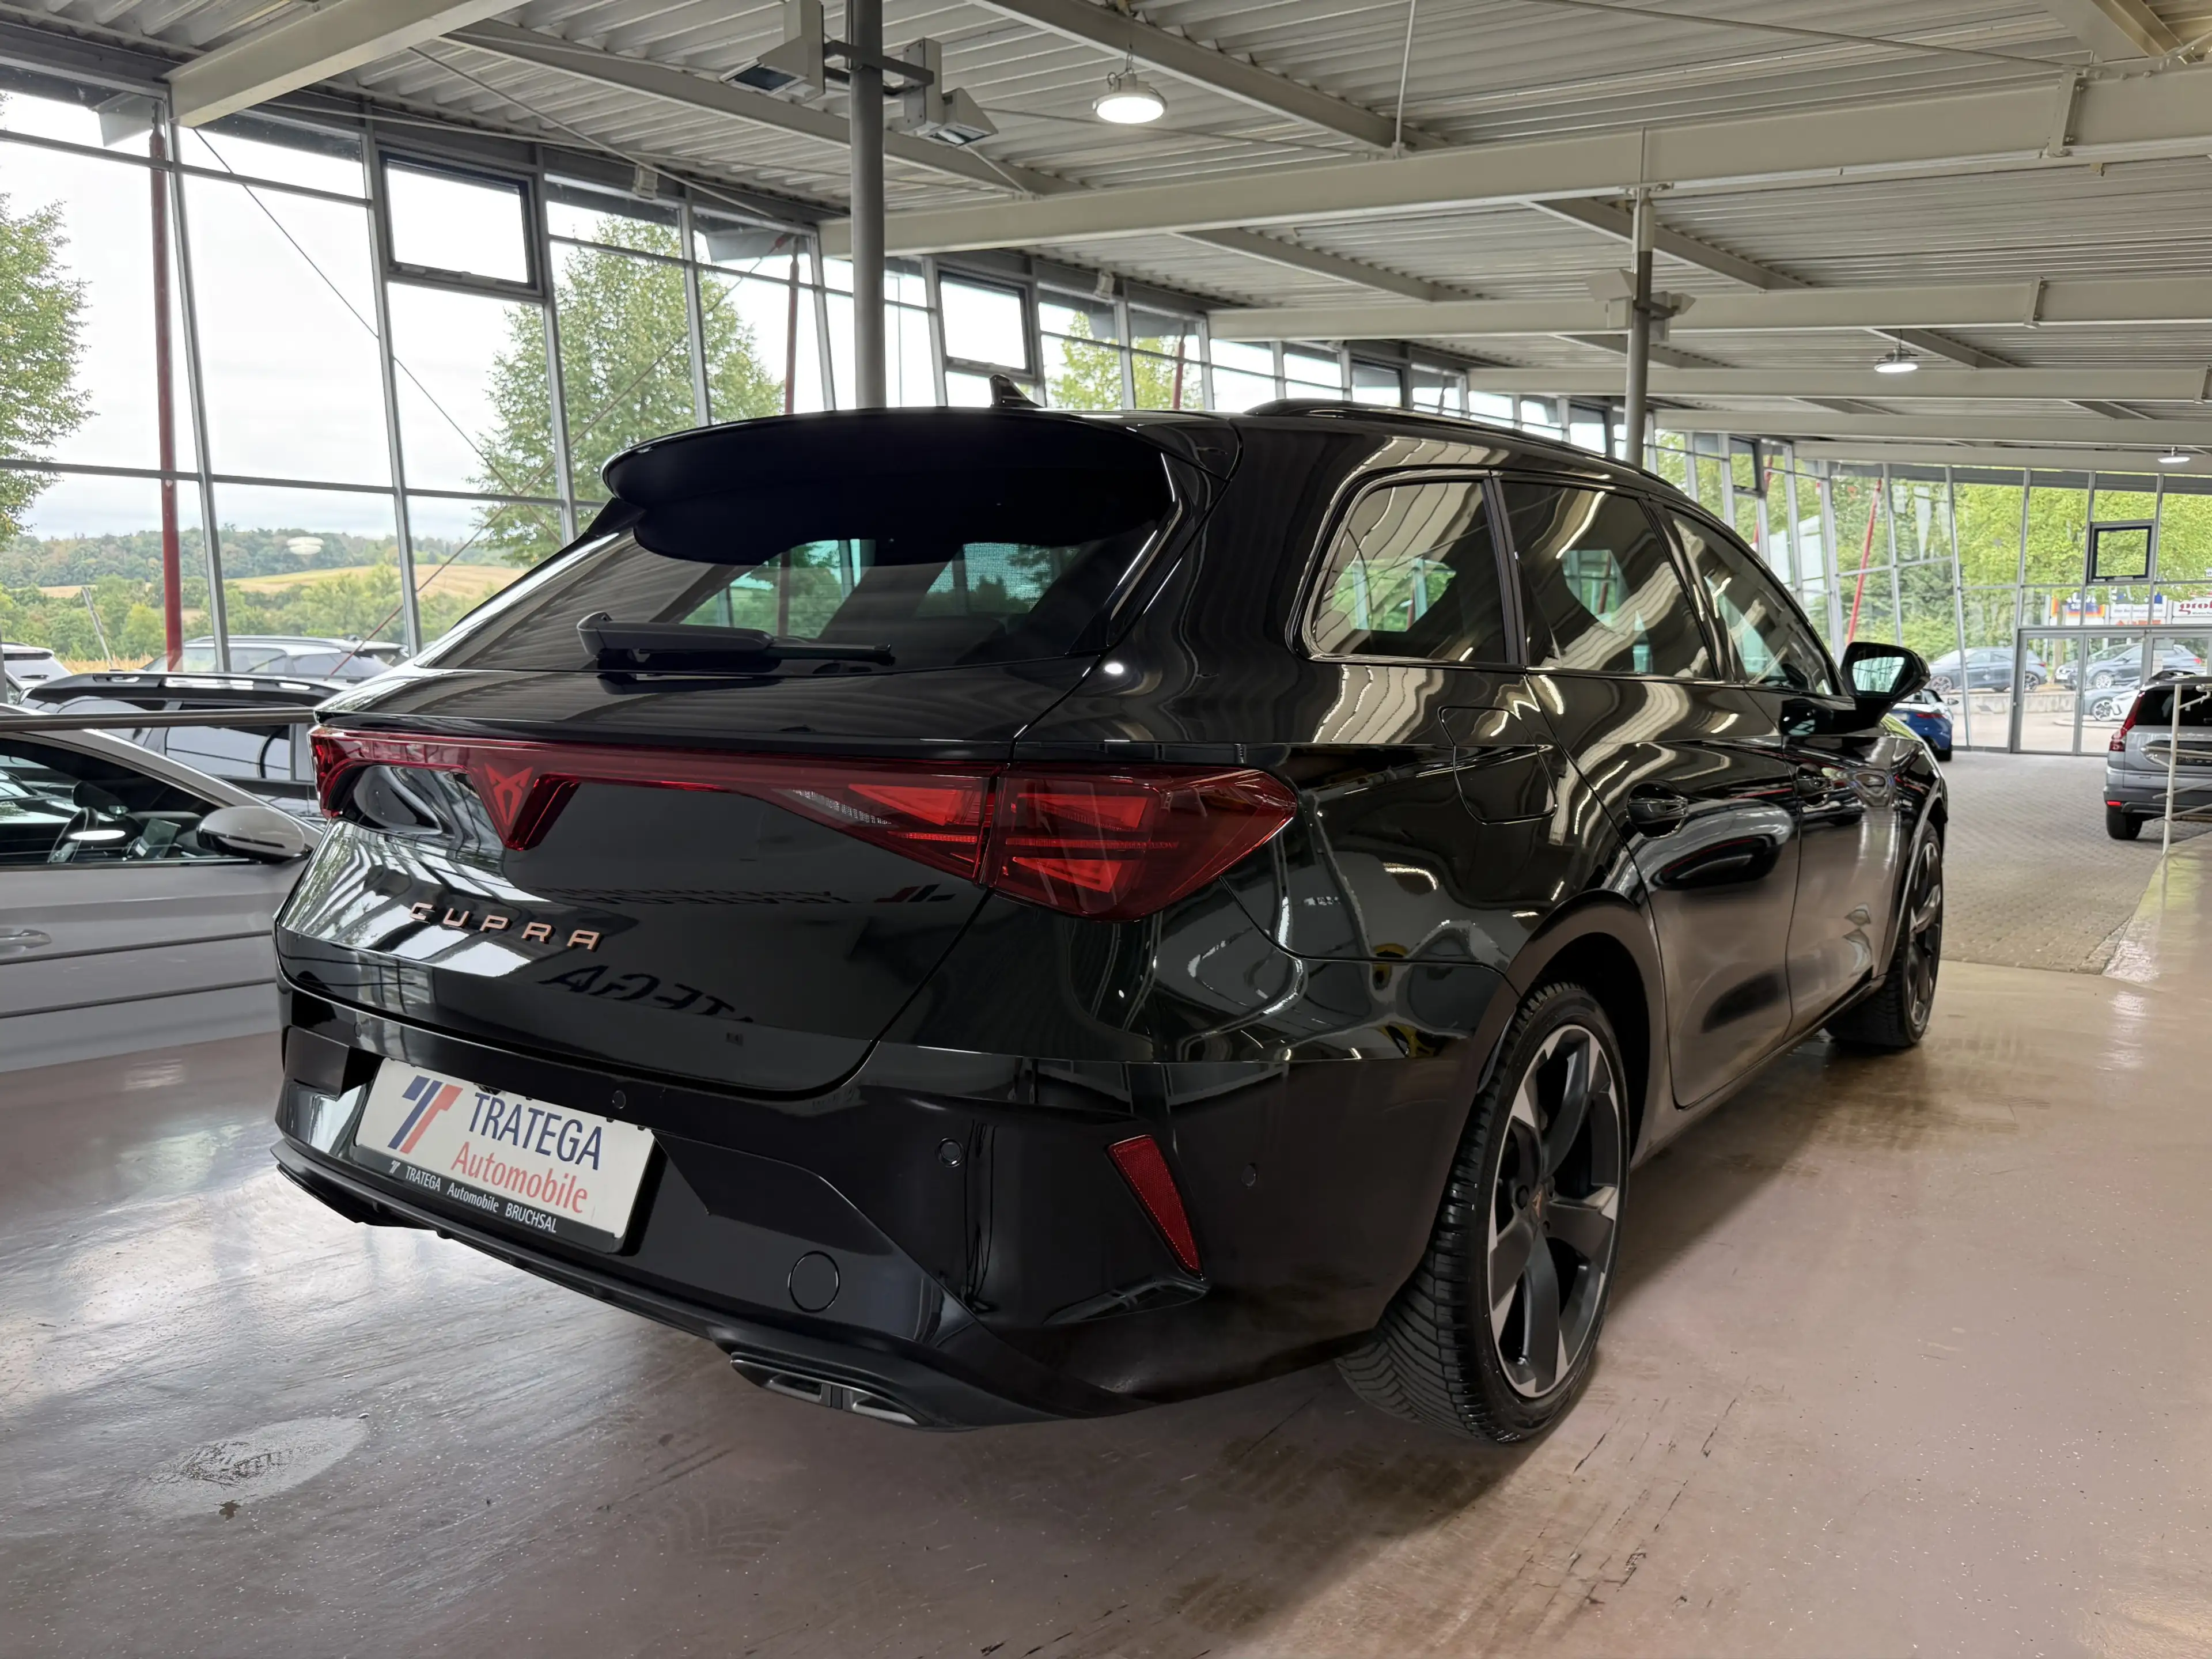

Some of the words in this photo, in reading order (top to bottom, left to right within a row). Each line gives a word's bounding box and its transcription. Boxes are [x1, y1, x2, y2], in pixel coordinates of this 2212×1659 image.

[408, 901, 605, 952] CUPRA
[468, 1092, 603, 1171] TRATEGA
[405, 1165, 441, 1192] TRATEGA
[446, 1181, 499, 1214] Automobile
[505, 1203, 558, 1234] BRUCHSAL
[450, 1141, 589, 1214] Automobile
